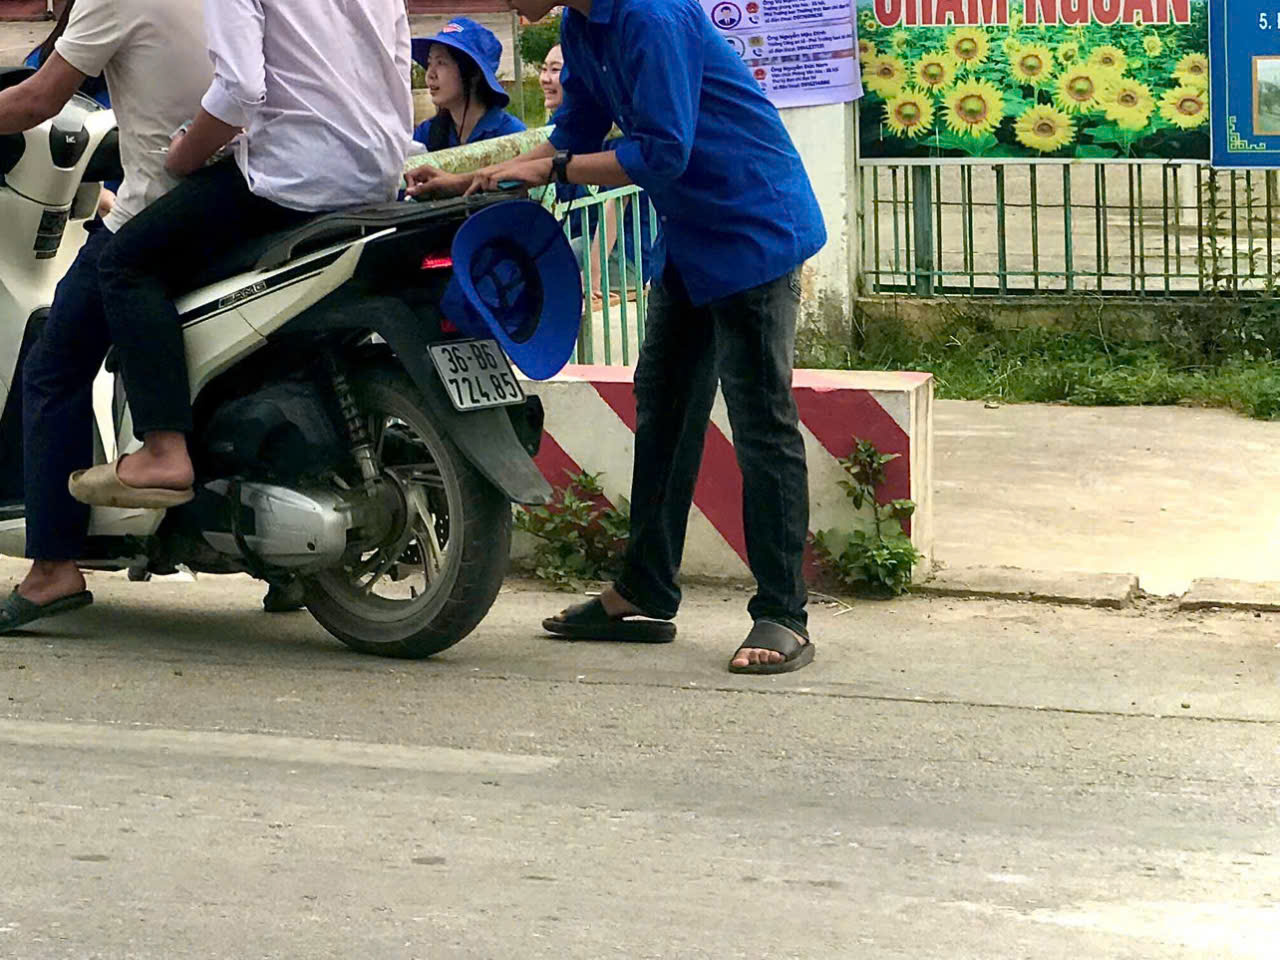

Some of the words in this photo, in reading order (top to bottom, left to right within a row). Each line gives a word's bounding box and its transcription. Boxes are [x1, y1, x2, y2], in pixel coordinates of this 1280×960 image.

[1259, 12, 1272, 30] 5.
[441, 343, 498, 374] 36-B6
[448, 372, 518, 406] 724.85
